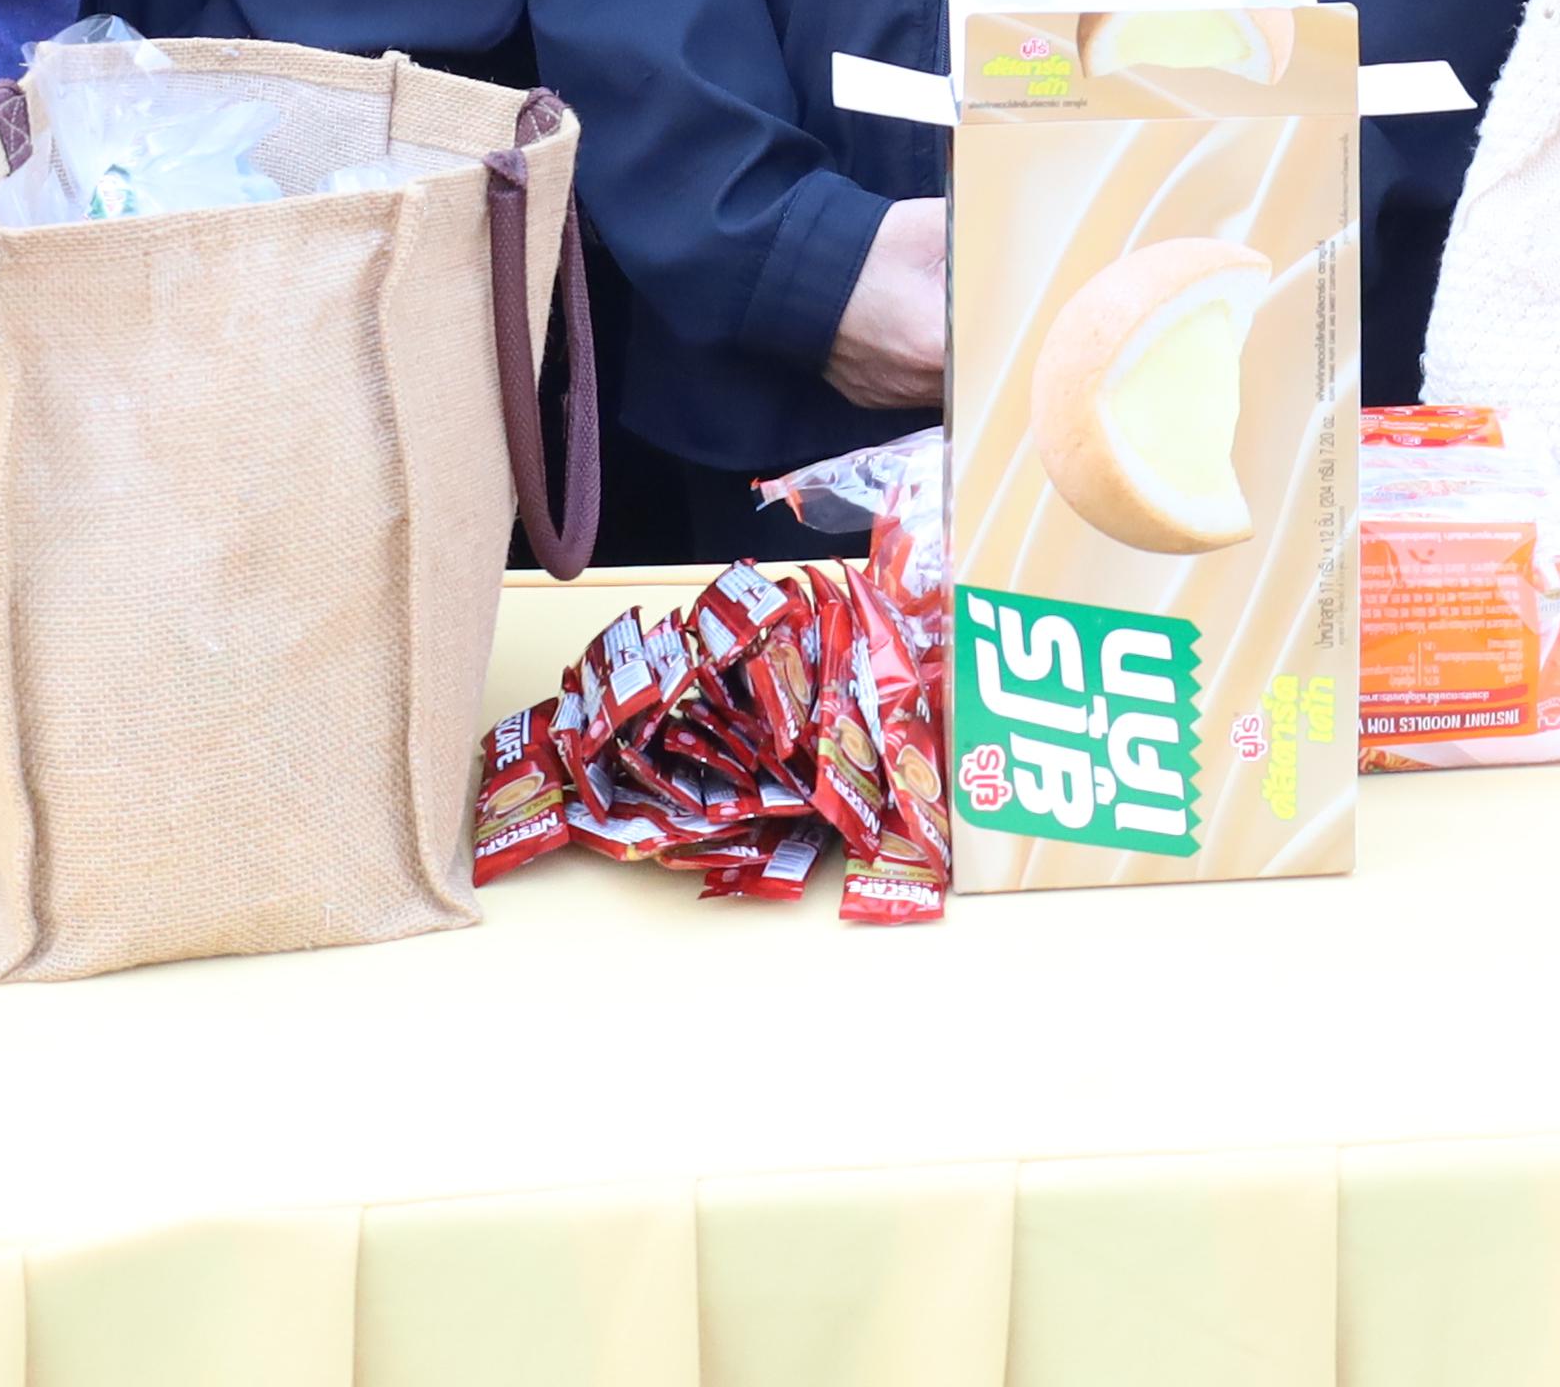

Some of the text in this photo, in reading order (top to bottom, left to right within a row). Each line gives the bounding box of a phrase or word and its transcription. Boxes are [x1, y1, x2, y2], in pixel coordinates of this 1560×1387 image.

[966, 591, 1117, 829] ยูโร่
[1087, 626, 1188, 836] เค้ก
[1366, 707, 1520, 733] INSTANT NOODLES TOM
